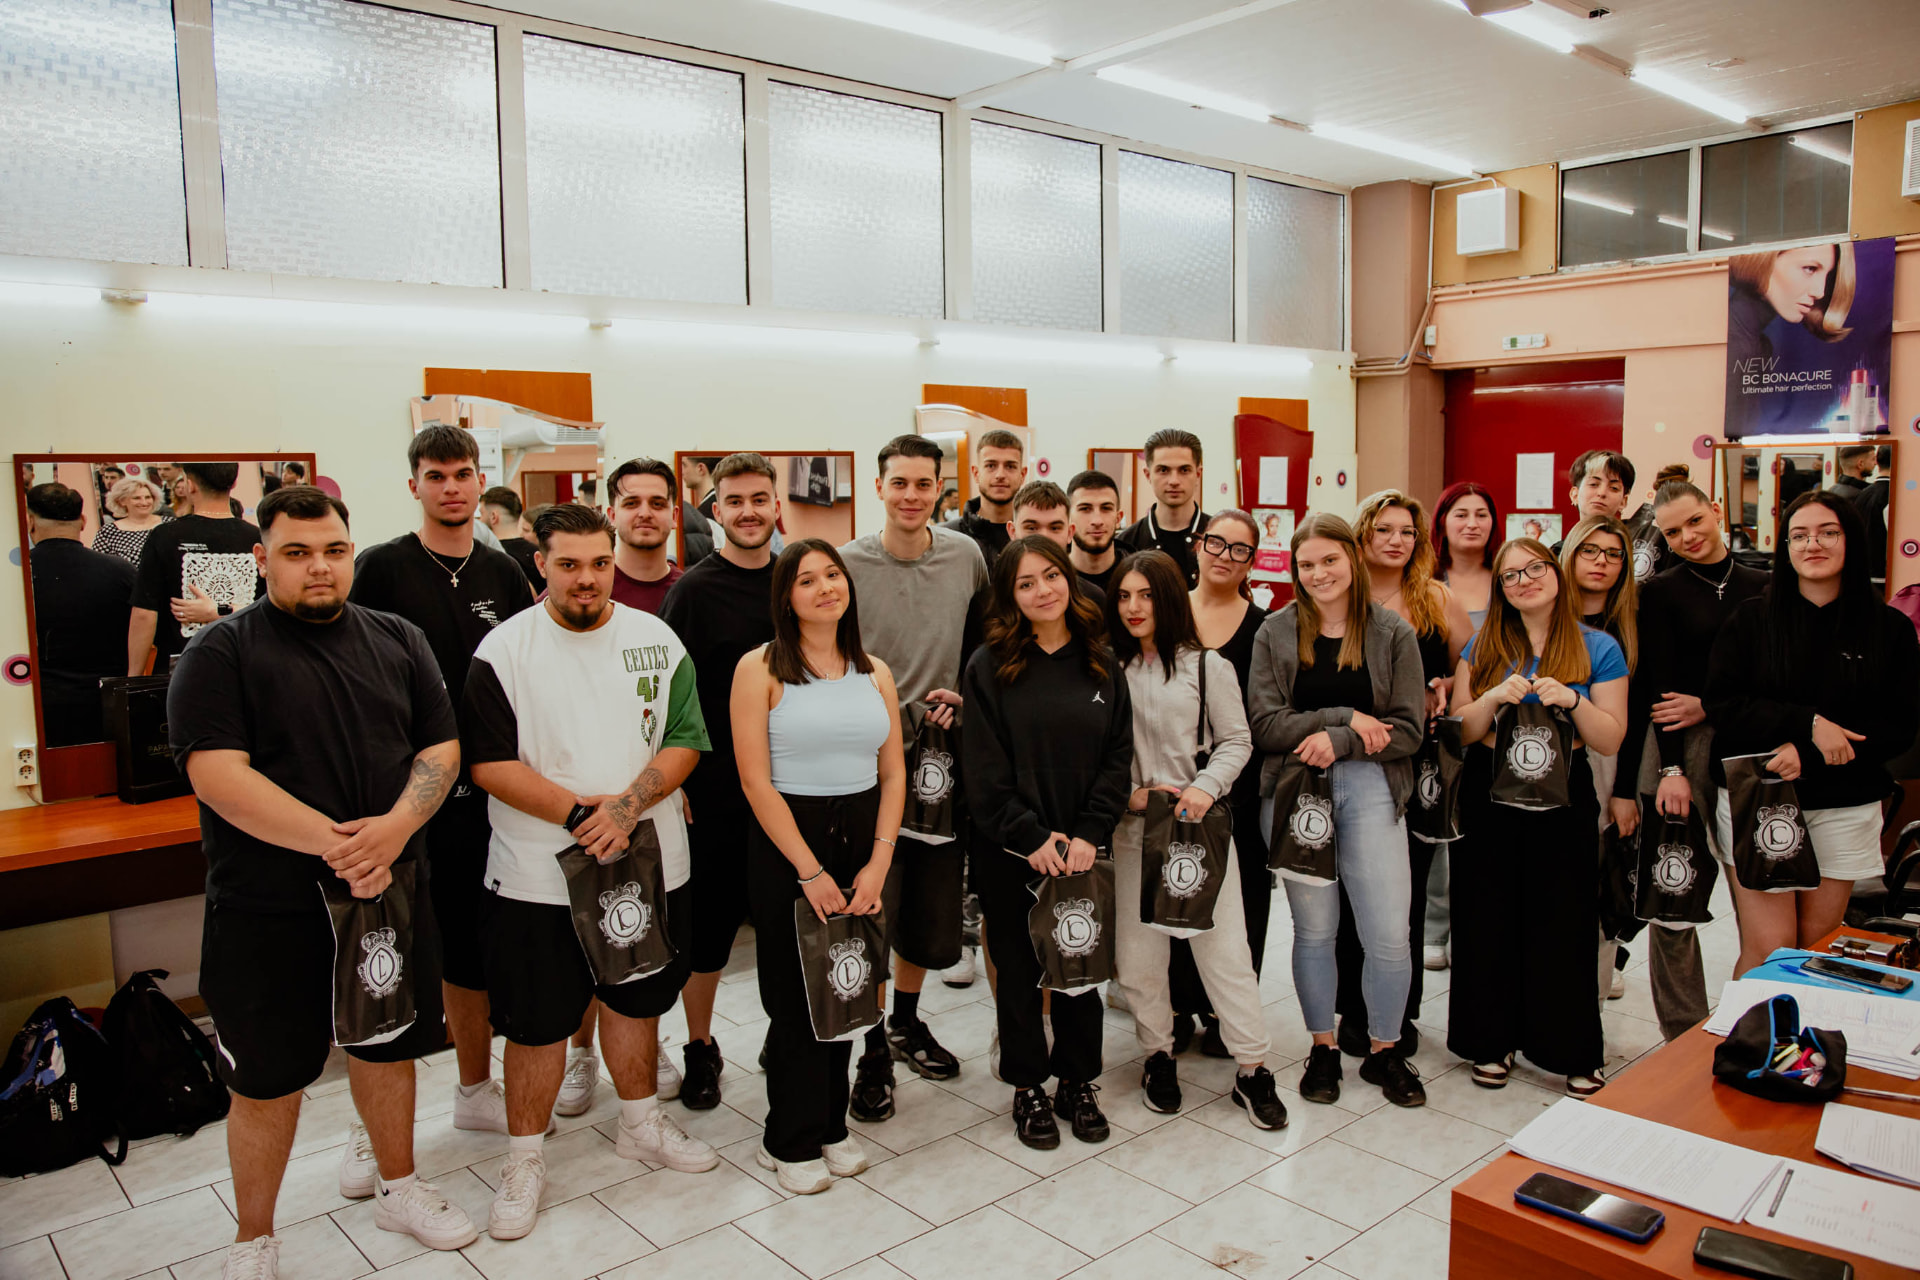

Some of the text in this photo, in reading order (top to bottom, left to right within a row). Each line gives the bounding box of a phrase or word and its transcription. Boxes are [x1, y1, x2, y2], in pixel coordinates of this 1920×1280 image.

[1733, 356, 1780, 373] NEW
[1742, 370, 1832, 385] BC BONACURE
[1742, 385, 1774, 394] Ultimate
[1791, 383, 1832, 392] perfection
